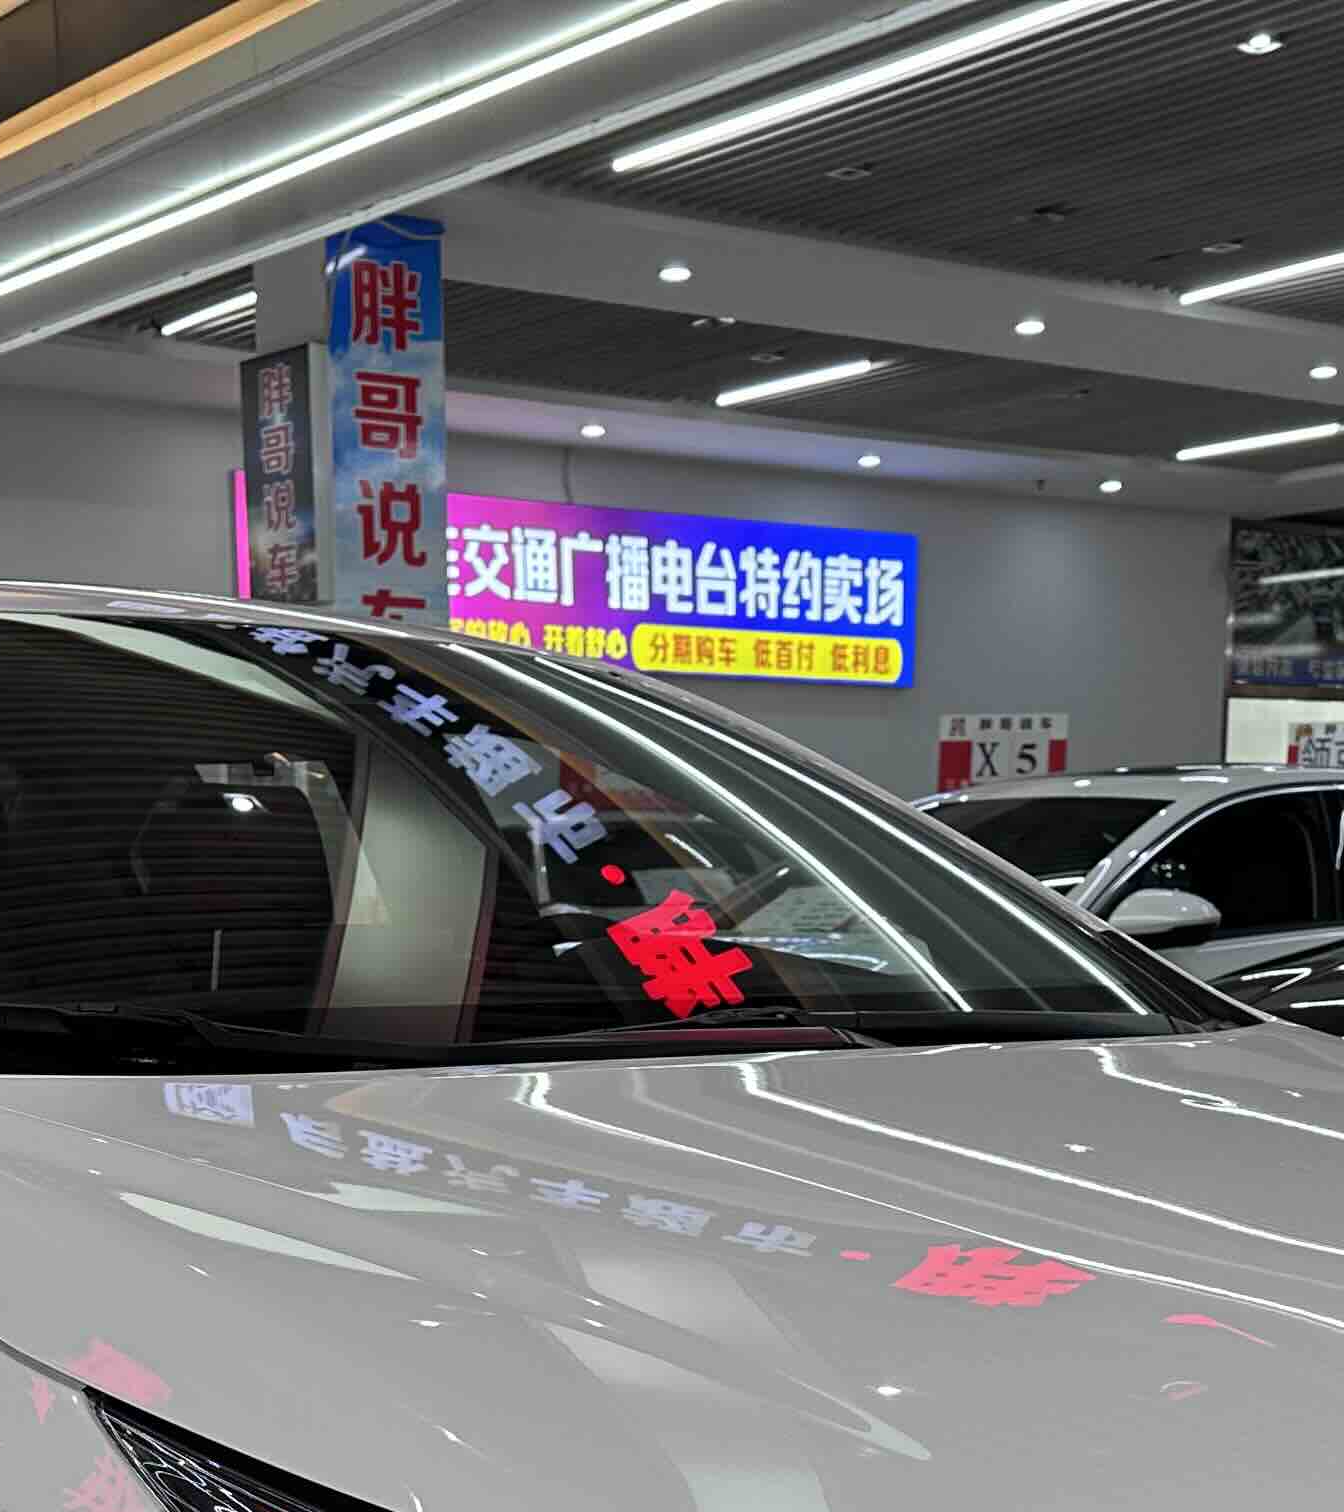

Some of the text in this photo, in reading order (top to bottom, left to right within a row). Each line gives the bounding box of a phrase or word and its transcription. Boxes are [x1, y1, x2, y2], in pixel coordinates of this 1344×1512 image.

[259, 362, 299, 593] 胖哥说车
[446, 523, 904, 627] 交通广播电台特约卖场
[649, 632, 738, 669] 分期购车
[753, 640, 815, 673] 低首付
[830, 644, 891, 675] 低利息
